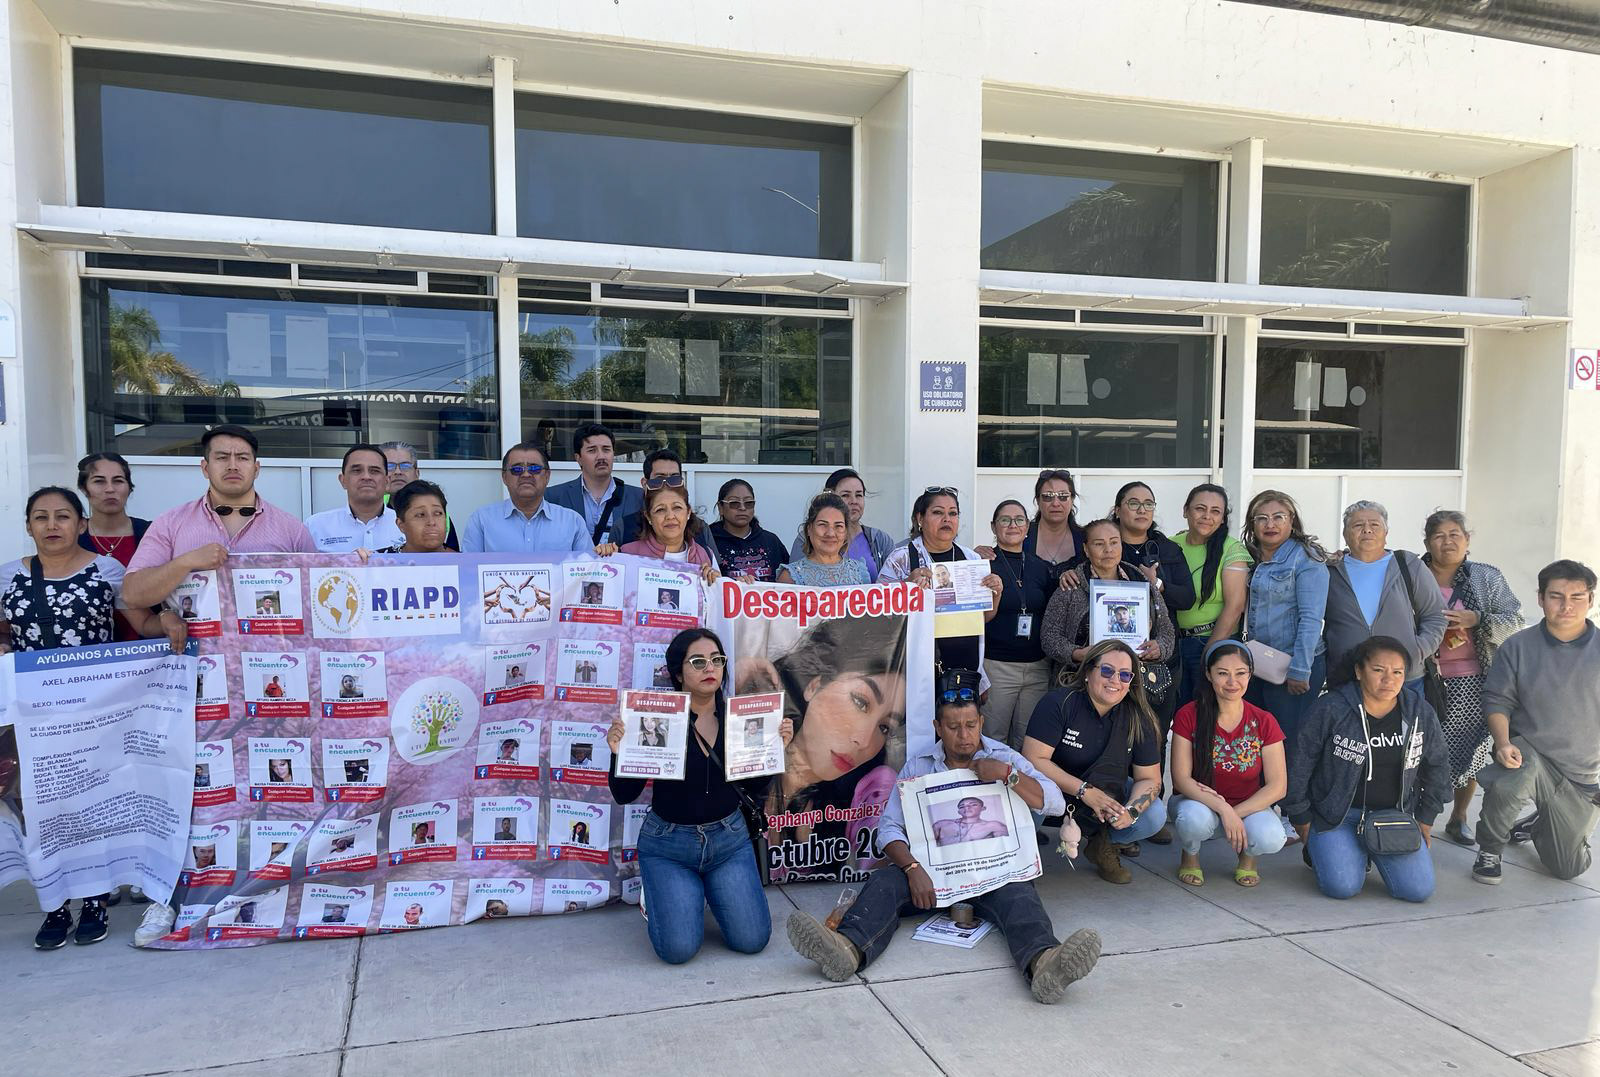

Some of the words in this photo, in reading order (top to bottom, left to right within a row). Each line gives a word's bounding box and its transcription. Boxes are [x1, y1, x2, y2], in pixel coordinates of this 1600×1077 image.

[372, 586, 459, 611] RIAPD
[723, 582, 924, 626] Desaparecida
[37, 650, 101, 665] AYÚDANOS
[104, 649, 112, 657] A
[116, 643, 171, 657] ENCONTR
[493, 652, 532, 660] encuentro
[42, 679, 65, 687] AXEL
[68, 674, 113, 685] ABRAHAM
[115, 667, 154, 678] ESTRADA
[56, 697, 86, 706] HOMBRE
[486, 728, 525, 736] encuentro
[48, 757, 72, 766] BLANCA
[60, 759, 87, 769] MEDIANA
[55, 766, 79, 775] GRANDE
[57, 768, 88, 780] POBLADAS
[398, 810, 439, 820] encuentro
[557, 809, 593, 818] encuentro
[766, 809, 822, 832] ephanya
[825, 804, 879, 821] González
[319, 825, 361, 835] encuentro
[768, 833, 850, 870] ctubre
[856, 827, 885, 859] 20
[935, 862, 966, 872] Desapareció
[989, 852, 1017, 863] Noviembre
